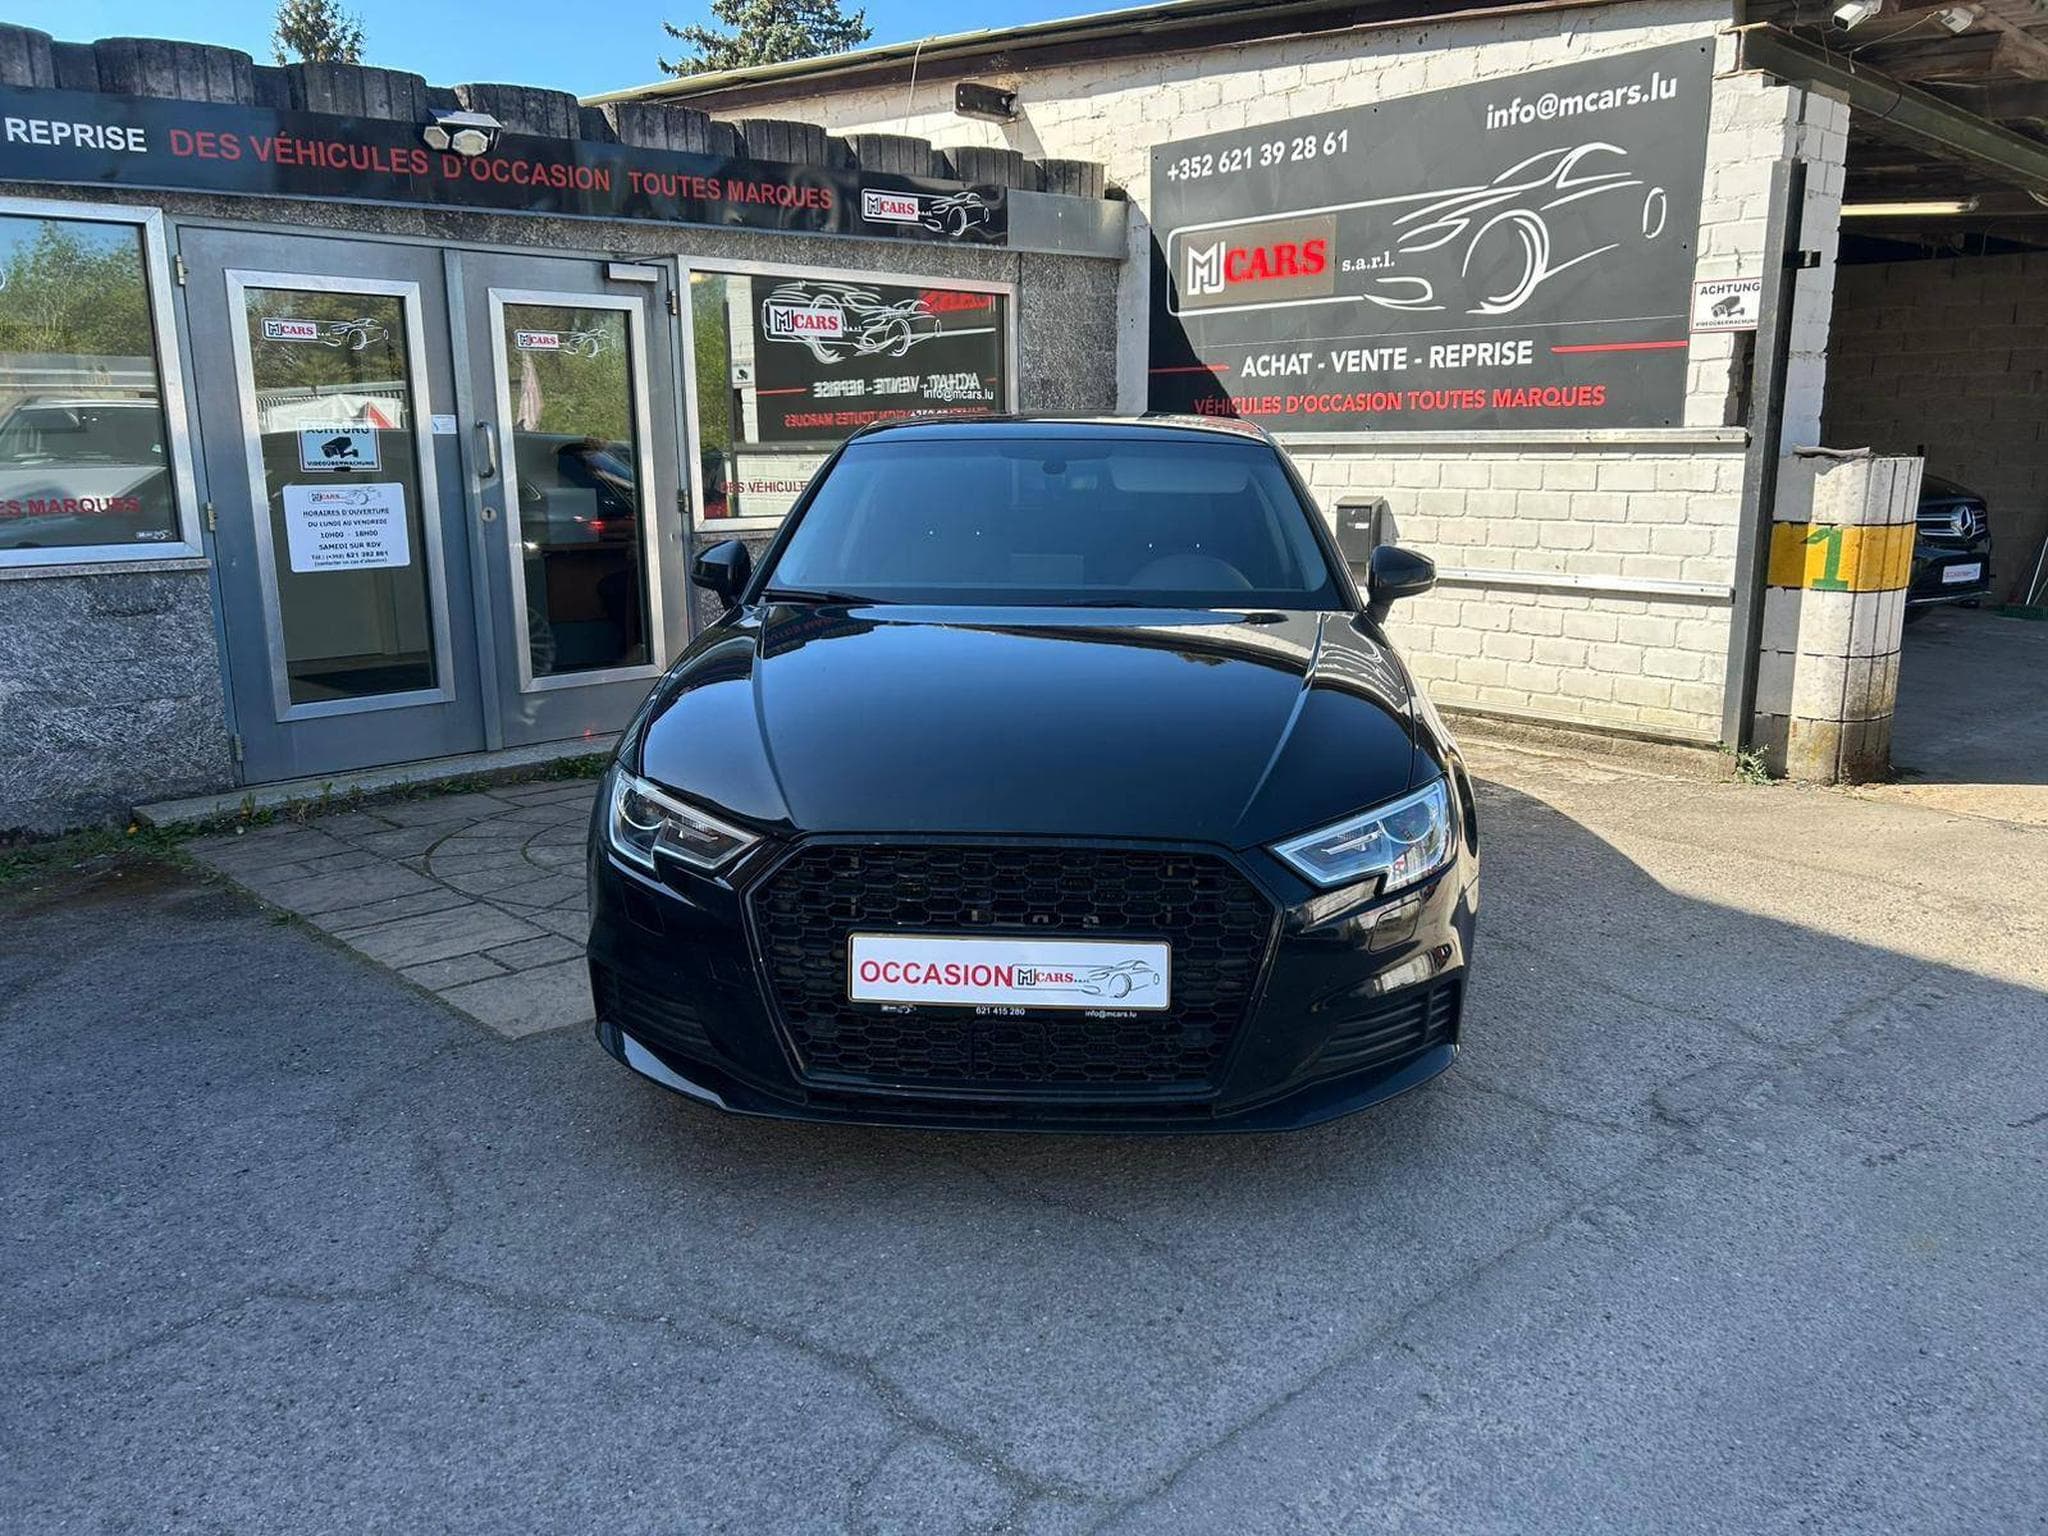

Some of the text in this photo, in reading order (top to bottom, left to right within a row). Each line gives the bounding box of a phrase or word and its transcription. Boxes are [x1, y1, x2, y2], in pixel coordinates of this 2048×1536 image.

[1486, 73, 1677, 130] info@mcars.lu
[5, 117, 833, 209] REPRISE DES VÉHICULES D'OCCASION TOUTES MARQUES
[1166, 129, 1349, 182] +352 621 39 28 61
[1341, 251, 1396, 272] s.a.r.l.
[1700, 282, 1760, 295] ACHTUNG
[1241, 352, 1312, 377] ACHAT
[1330, 347, 1408, 374] VENTE
[1429, 340, 1533, 369] REPRISE
[923, 388, 994, 401] info@mcars.lu
[1194, 385, 1607, 416] VÉHICULES D'OCCASION TOUTES MARQUES
[748, 478, 808, 493] VÉHICULE
[28, 496, 141, 515] MARQUES
[1801, 527, 1849, 592] 1
[860, 960, 1013, 987] OCCASION
